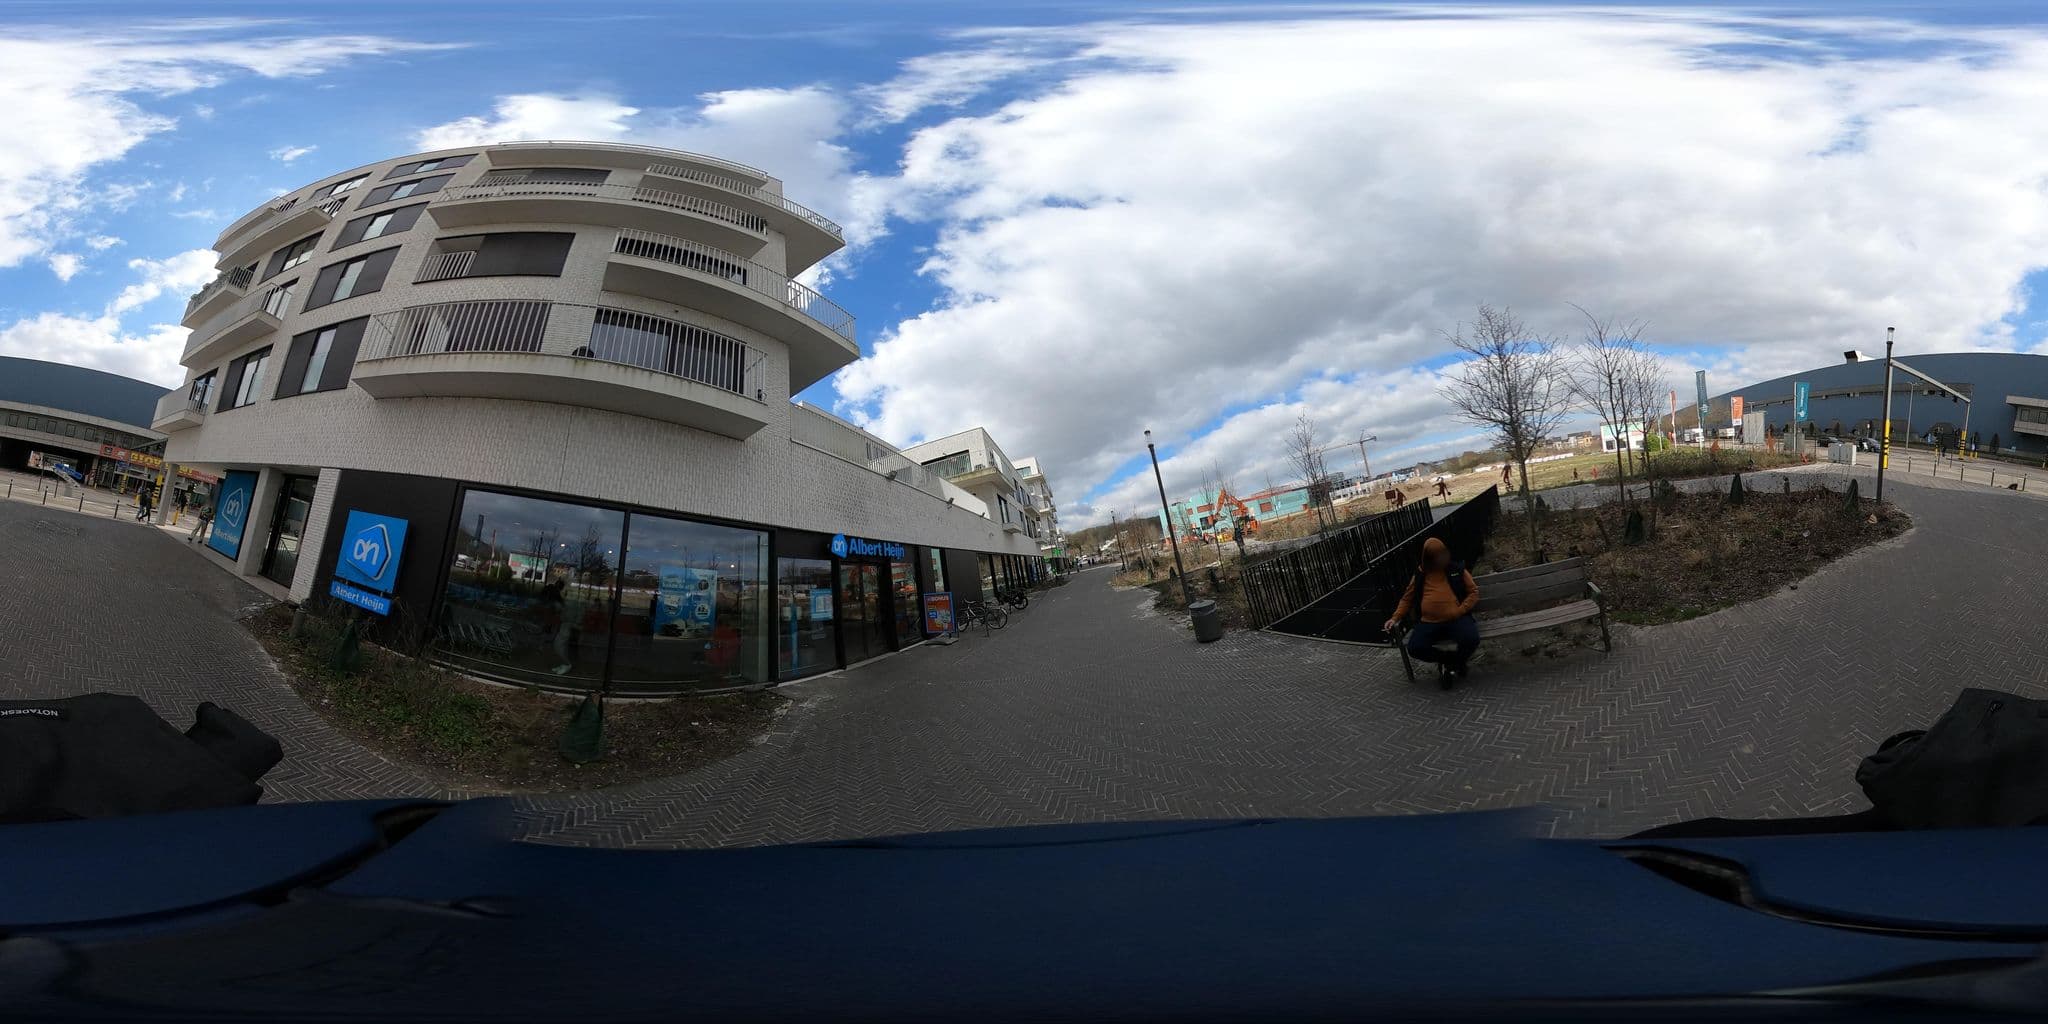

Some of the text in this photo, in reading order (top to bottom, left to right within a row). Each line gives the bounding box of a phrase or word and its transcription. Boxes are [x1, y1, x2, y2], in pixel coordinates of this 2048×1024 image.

[849, 538, 882, 556] Albert
[884, 542, 905, 560] Heijn
[335, 585, 384, 611] Albert Heijn
